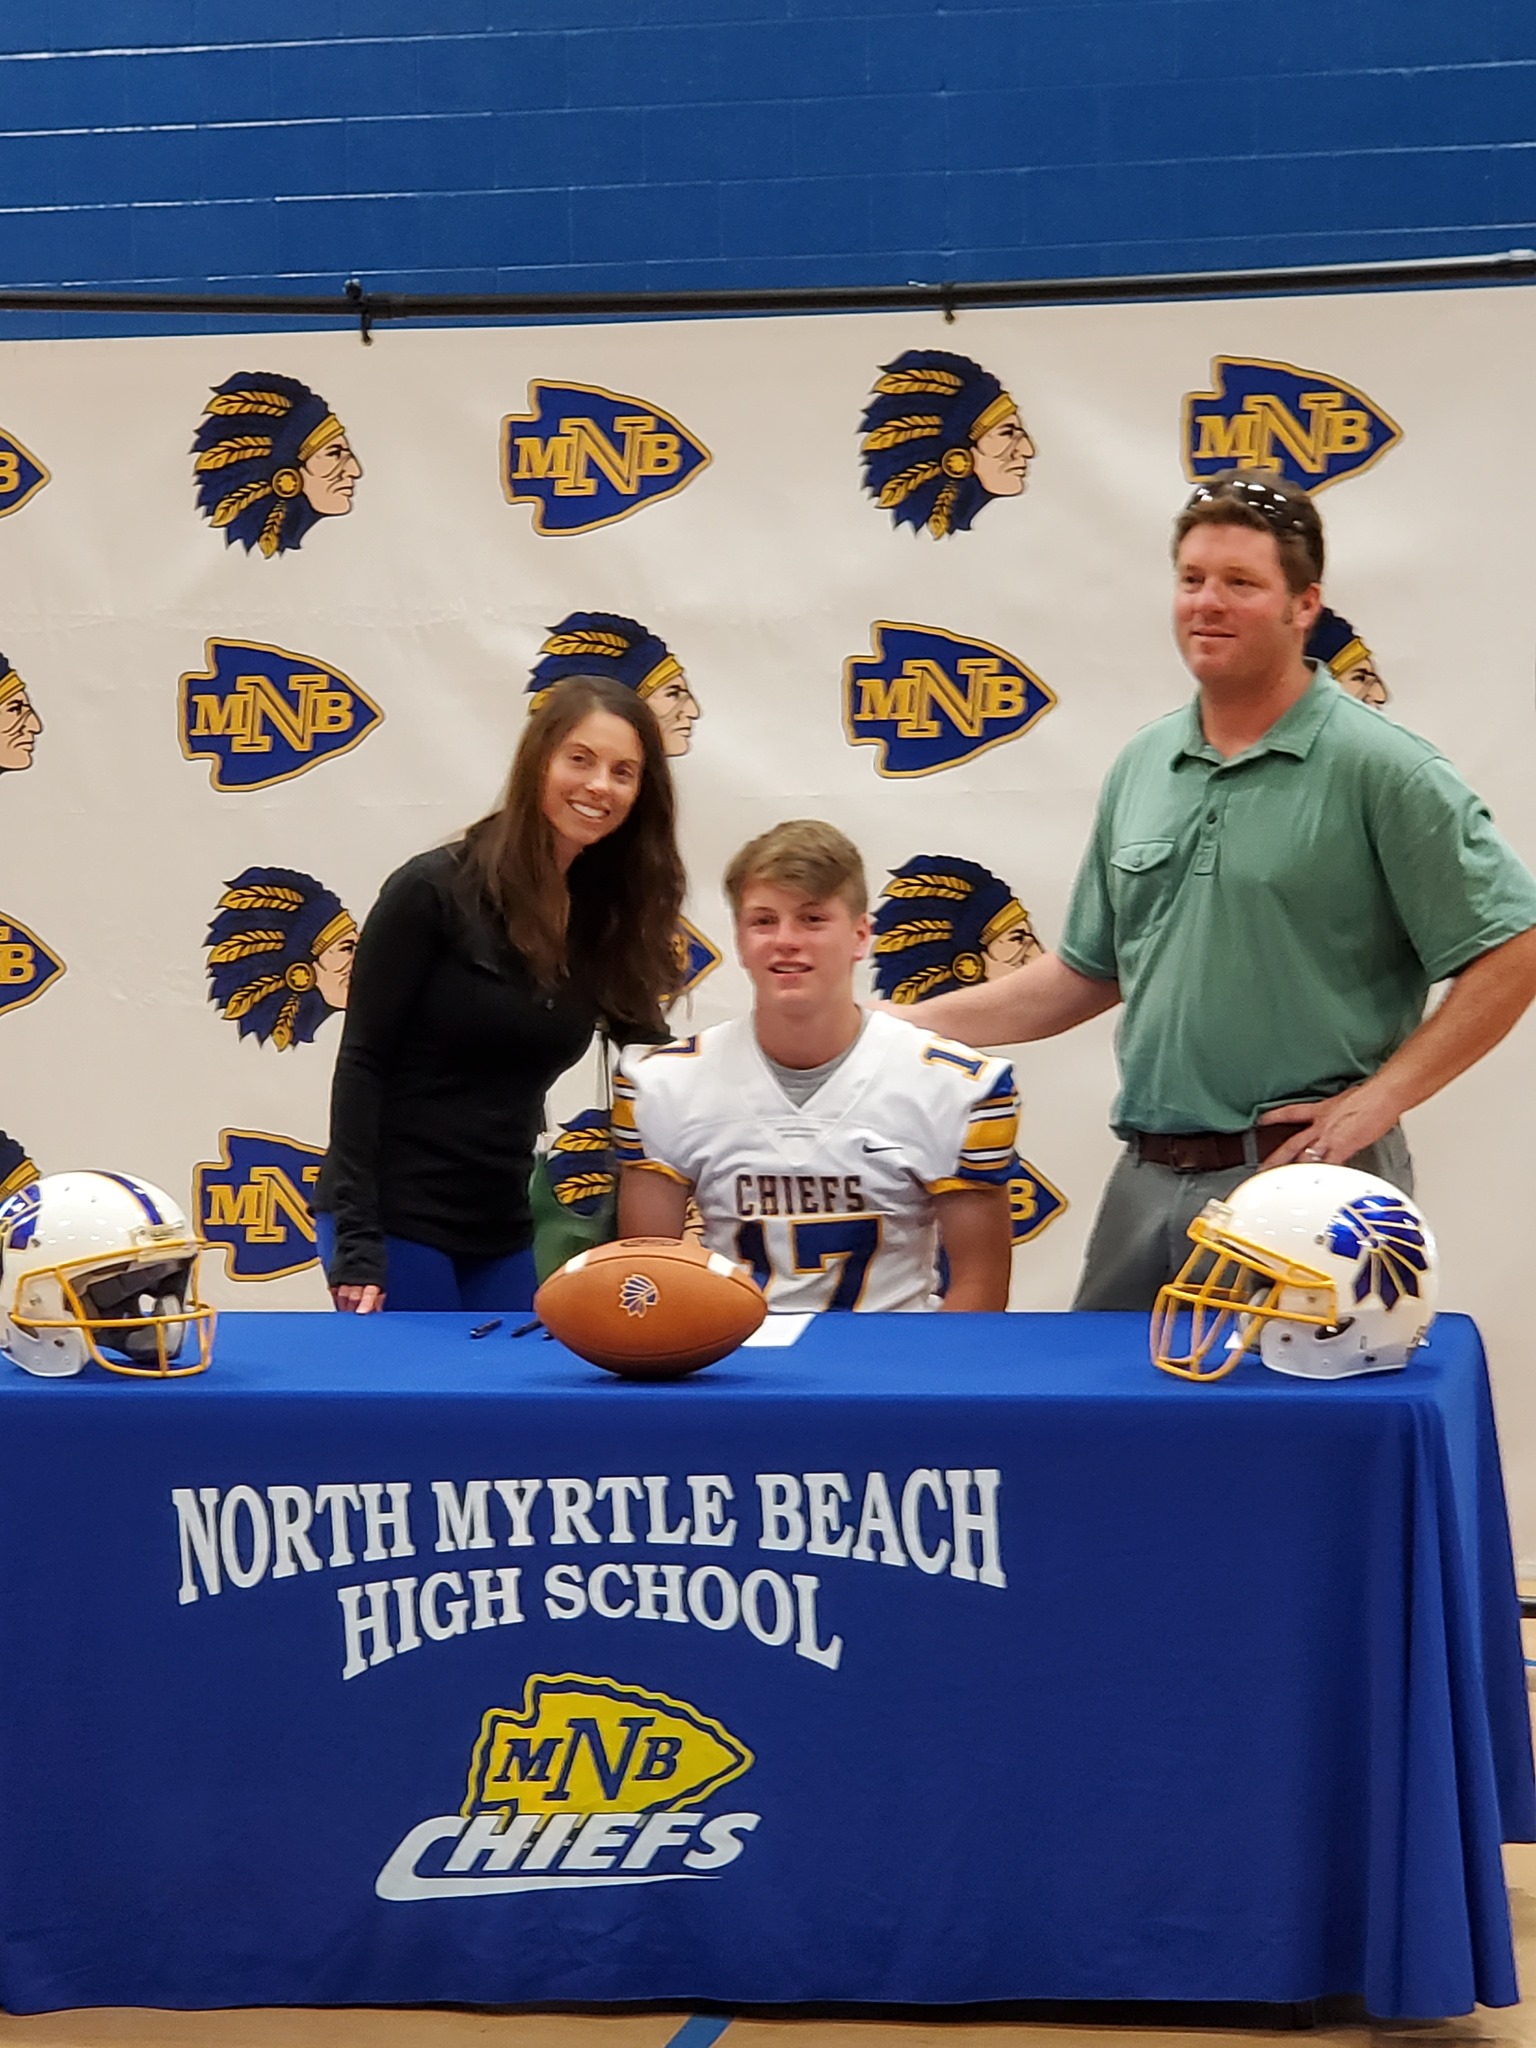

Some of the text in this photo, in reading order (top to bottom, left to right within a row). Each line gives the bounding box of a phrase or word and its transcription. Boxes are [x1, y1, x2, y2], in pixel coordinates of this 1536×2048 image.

[513, 416, 683, 496] MNB
[1193, 392, 1370, 474] MNB
[190, 674, 354, 753] MNB
[854, 658, 1026, 738] MNB
[921, 1035, 988, 1082] 1
[204, 1167, 320, 1243] MN
[736, 1174, 865, 1216] CHIEFS
[734, 1214, 884, 1313] 17
[172, 1468, 1007, 1605] NORTH MYRTLE BEACH
[338, 1563, 843, 1681] HIGH SCHOOL
[493, 1716, 683, 1801] MNB
[375, 1812, 762, 1902] CHIEFS
